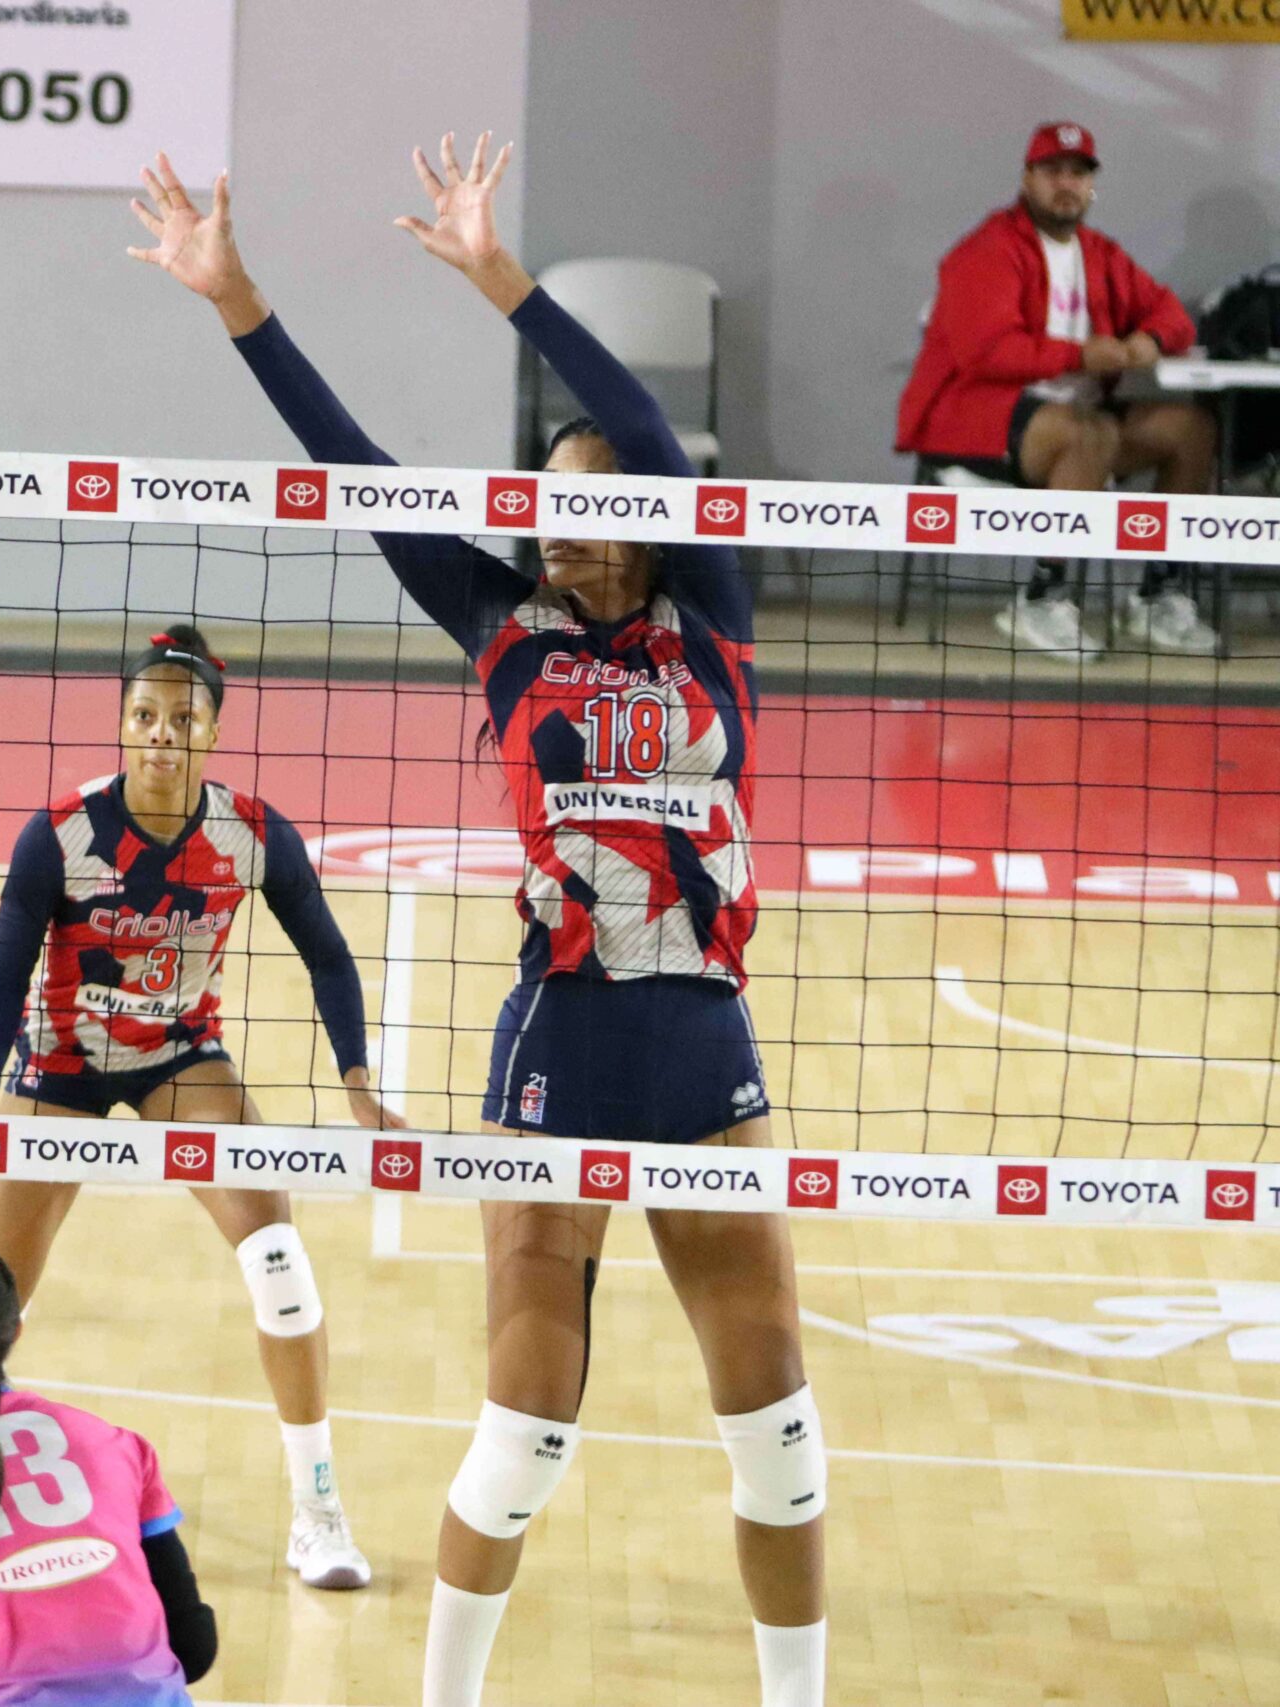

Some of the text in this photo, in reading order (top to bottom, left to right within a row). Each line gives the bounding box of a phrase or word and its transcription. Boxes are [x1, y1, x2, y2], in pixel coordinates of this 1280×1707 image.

[132, 478, 250, 503] TOYOTA
[340, 486, 459, 510] TOYOTA
[550, 494, 669, 519] TOYOTA
[760, 502, 878, 526] TOYOTA
[971, 509, 1090, 534] TOYOTA
[1181, 517, 1280, 540] TOYOT
[583, 691, 669, 779] 18
[554, 791, 700, 818] UNIVERSAL
[88, 906, 233, 937] Criollas
[140, 941, 182, 996] 3
[527, 1072, 548, 1091] 21
[21, 1139, 139, 1165] TOYOTA
[228, 1148, 346, 1174] TOYOTA
[434, 1157, 552, 1183] TOYOTA
[643, 1167, 761, 1192] TOYOTA
[852, 1175, 970, 1199] TOYOTA
[1061, 1181, 1179, 1204] TOYOTA
[534, 1447, 563, 1461] errea
[0, 1547, 113, 1585] TROPIGAS
